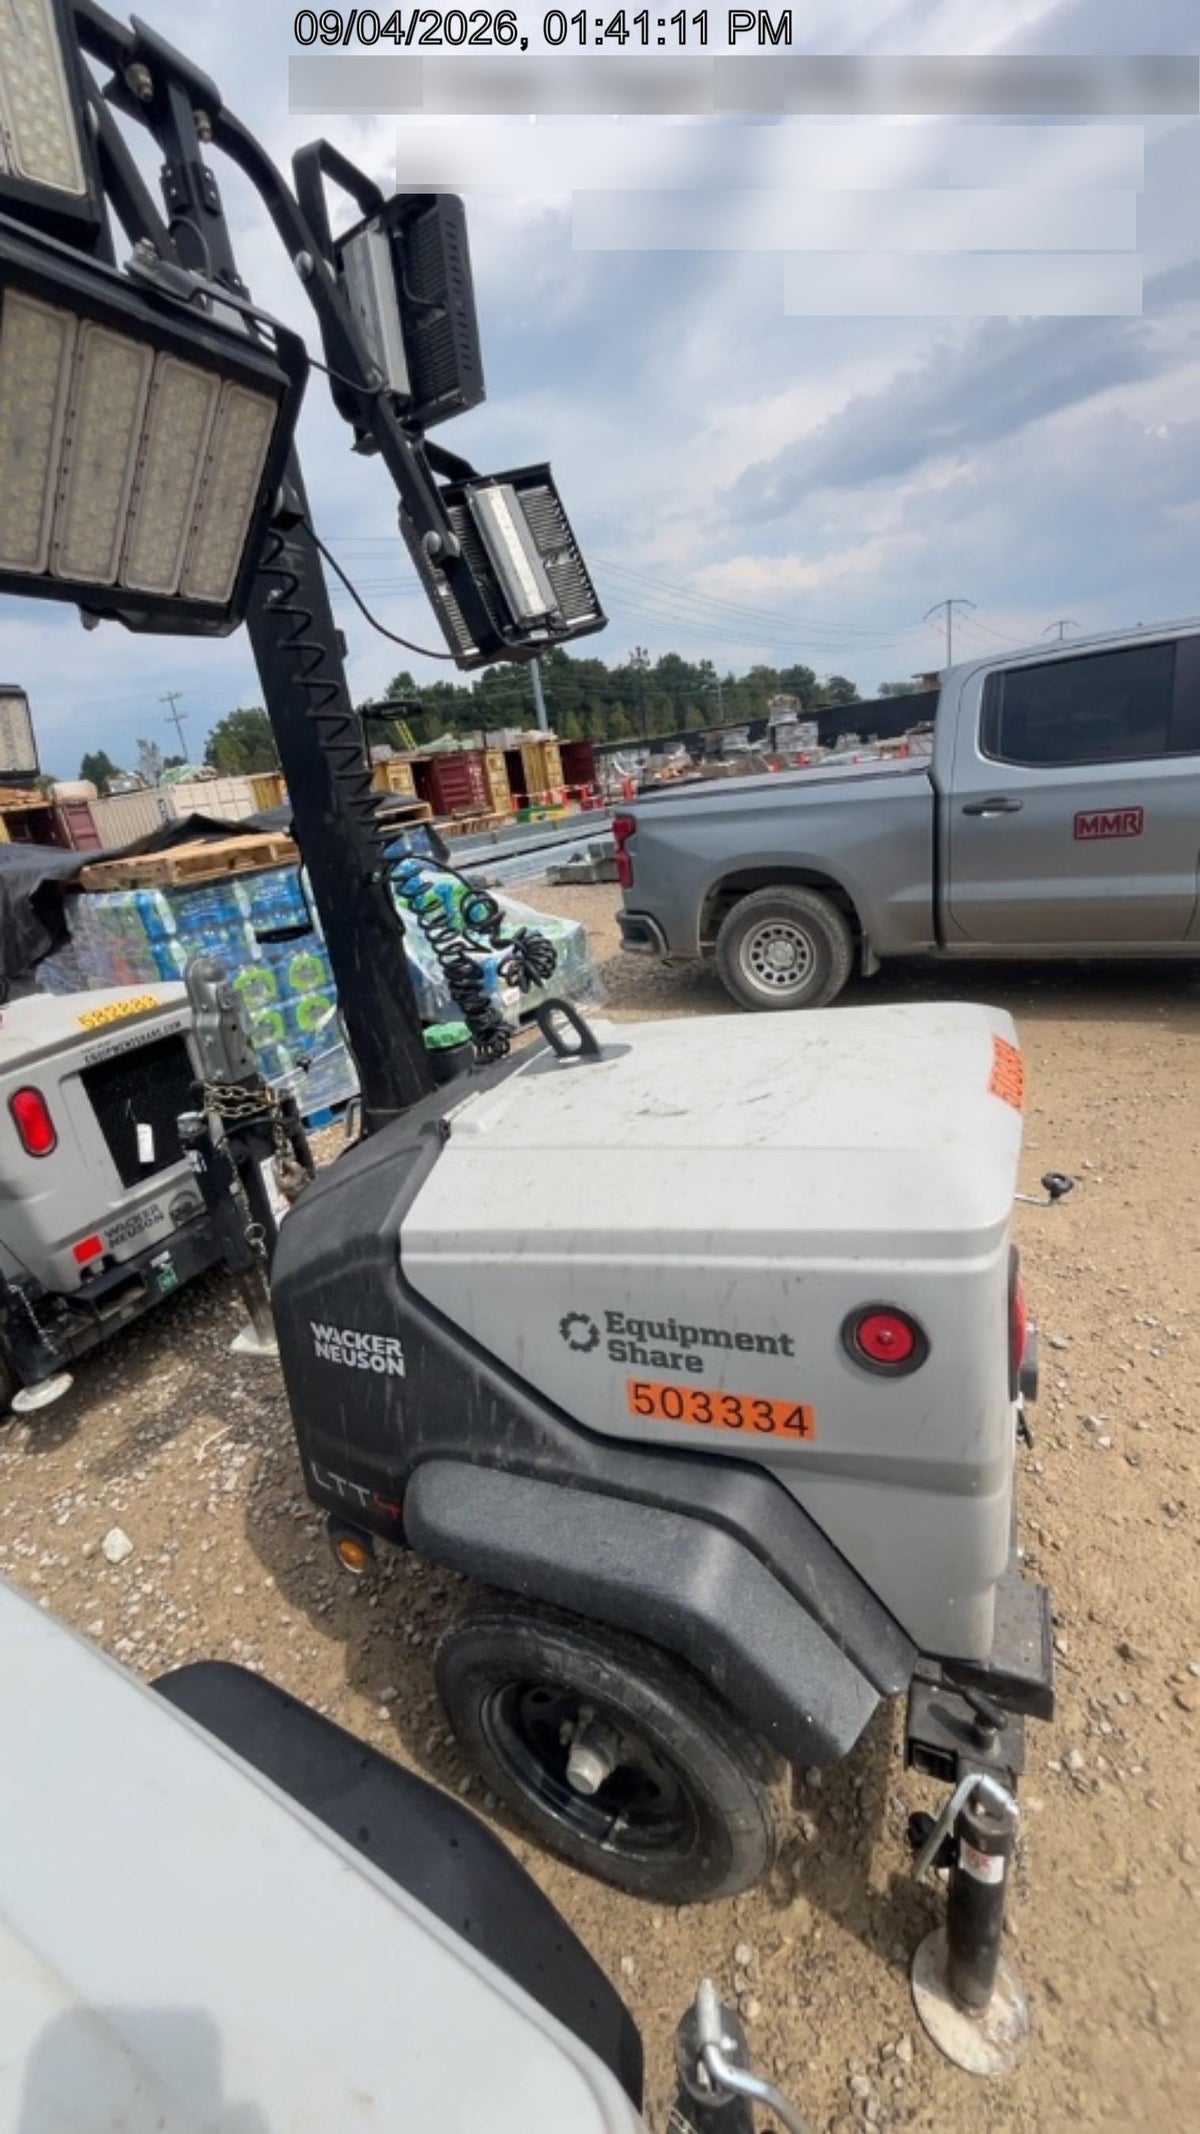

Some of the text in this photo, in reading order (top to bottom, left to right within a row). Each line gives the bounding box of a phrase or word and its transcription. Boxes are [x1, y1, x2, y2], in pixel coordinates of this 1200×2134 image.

[1078, 812, 1138, 836] MMR
[310, 1321, 404, 1357] WACKER
[603, 1310, 796, 1358] Equipment
[314, 1340, 406, 1377] NEUSON
[607, 1339, 705, 1374] Share
[631, 1381, 811, 1438] 503334
